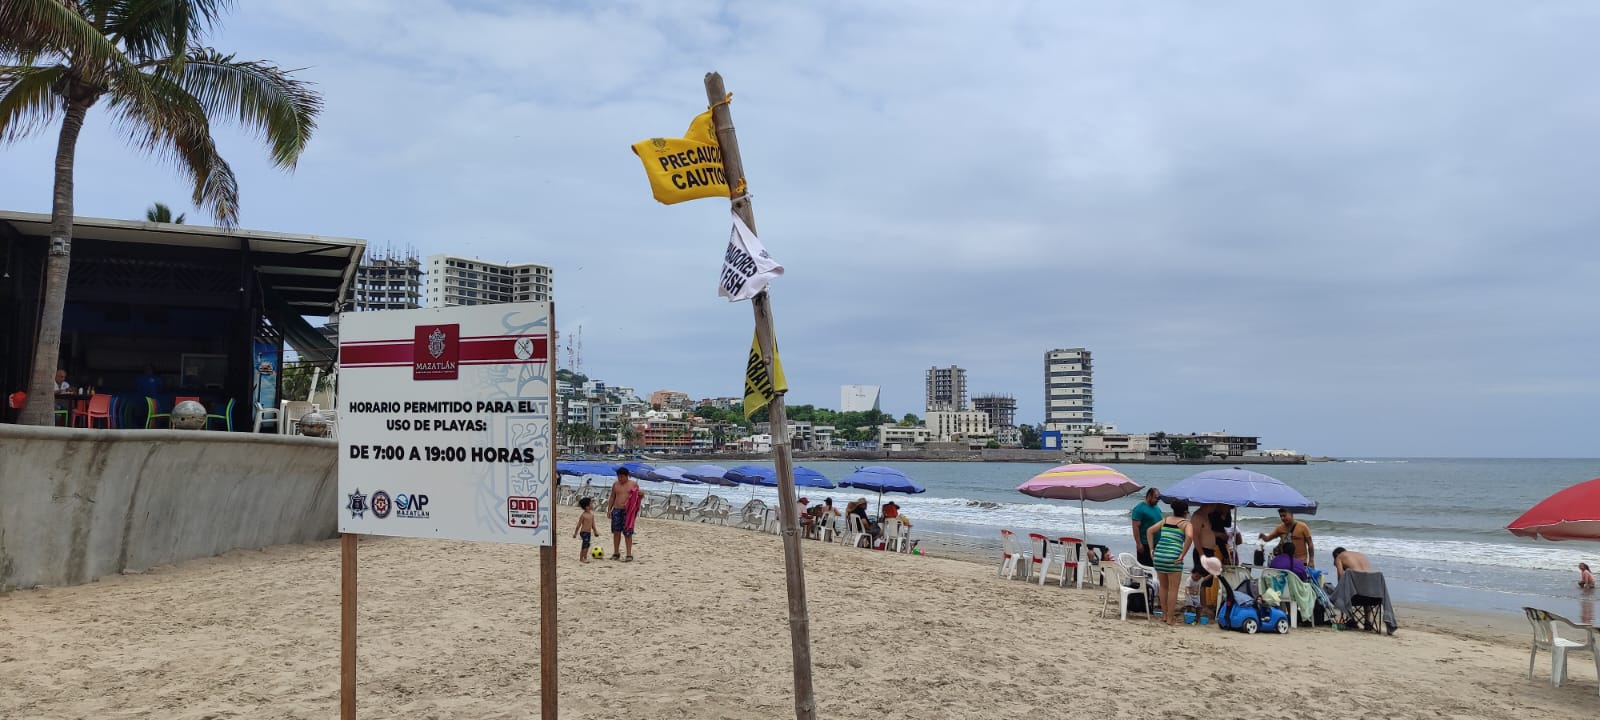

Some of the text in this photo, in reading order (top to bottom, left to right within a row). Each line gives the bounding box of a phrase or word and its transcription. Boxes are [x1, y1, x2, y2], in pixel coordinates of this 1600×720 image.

[723, 268, 747, 296] FISH
[416, 360, 456, 370] MAZATLÁN
[350, 401, 536, 413] HORARIO PERMITIDO PARA EL
[386, 419, 487, 431] USO DE PLAYAS:
[350, 445, 535, 463] DE 7:00 A 19:00 HORAS
[510, 500, 534, 510] 911
